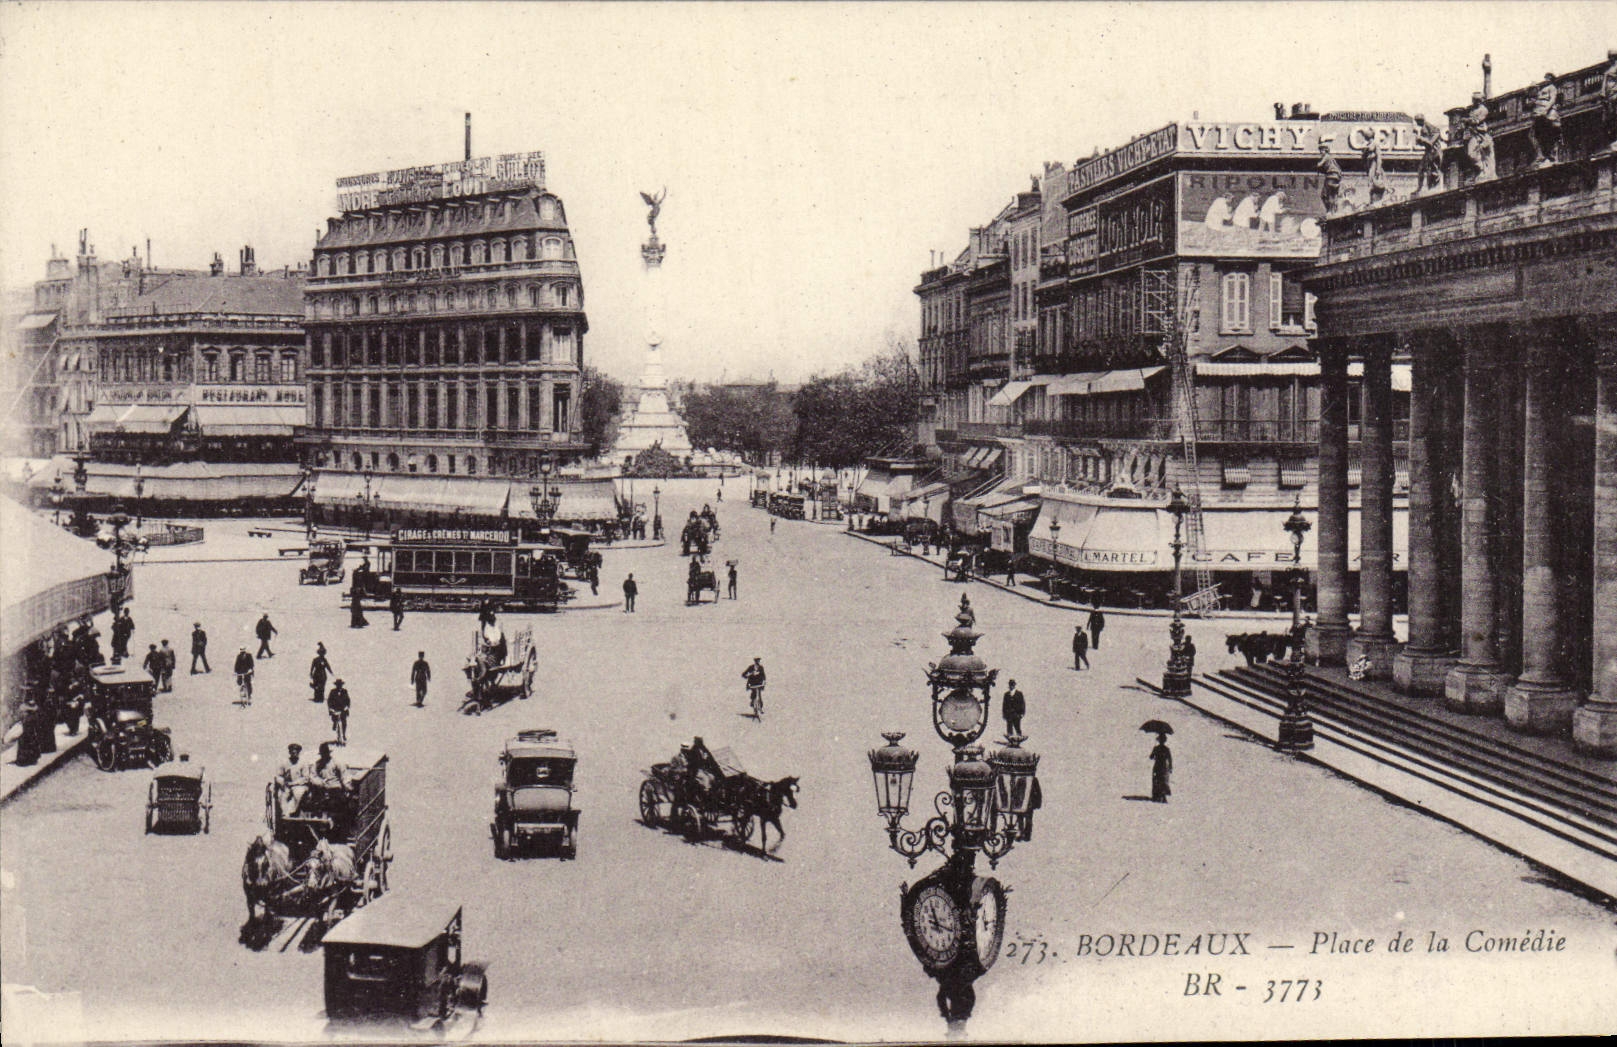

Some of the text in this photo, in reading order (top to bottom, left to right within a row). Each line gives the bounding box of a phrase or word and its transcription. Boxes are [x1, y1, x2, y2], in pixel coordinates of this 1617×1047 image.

[1186, 125, 1312, 150] VICHY
[1068, 155, 1115, 194] PASTILLES
[1188, 174, 1320, 190] RIPOLIN
[398, 529, 427, 541] CIRAGE
